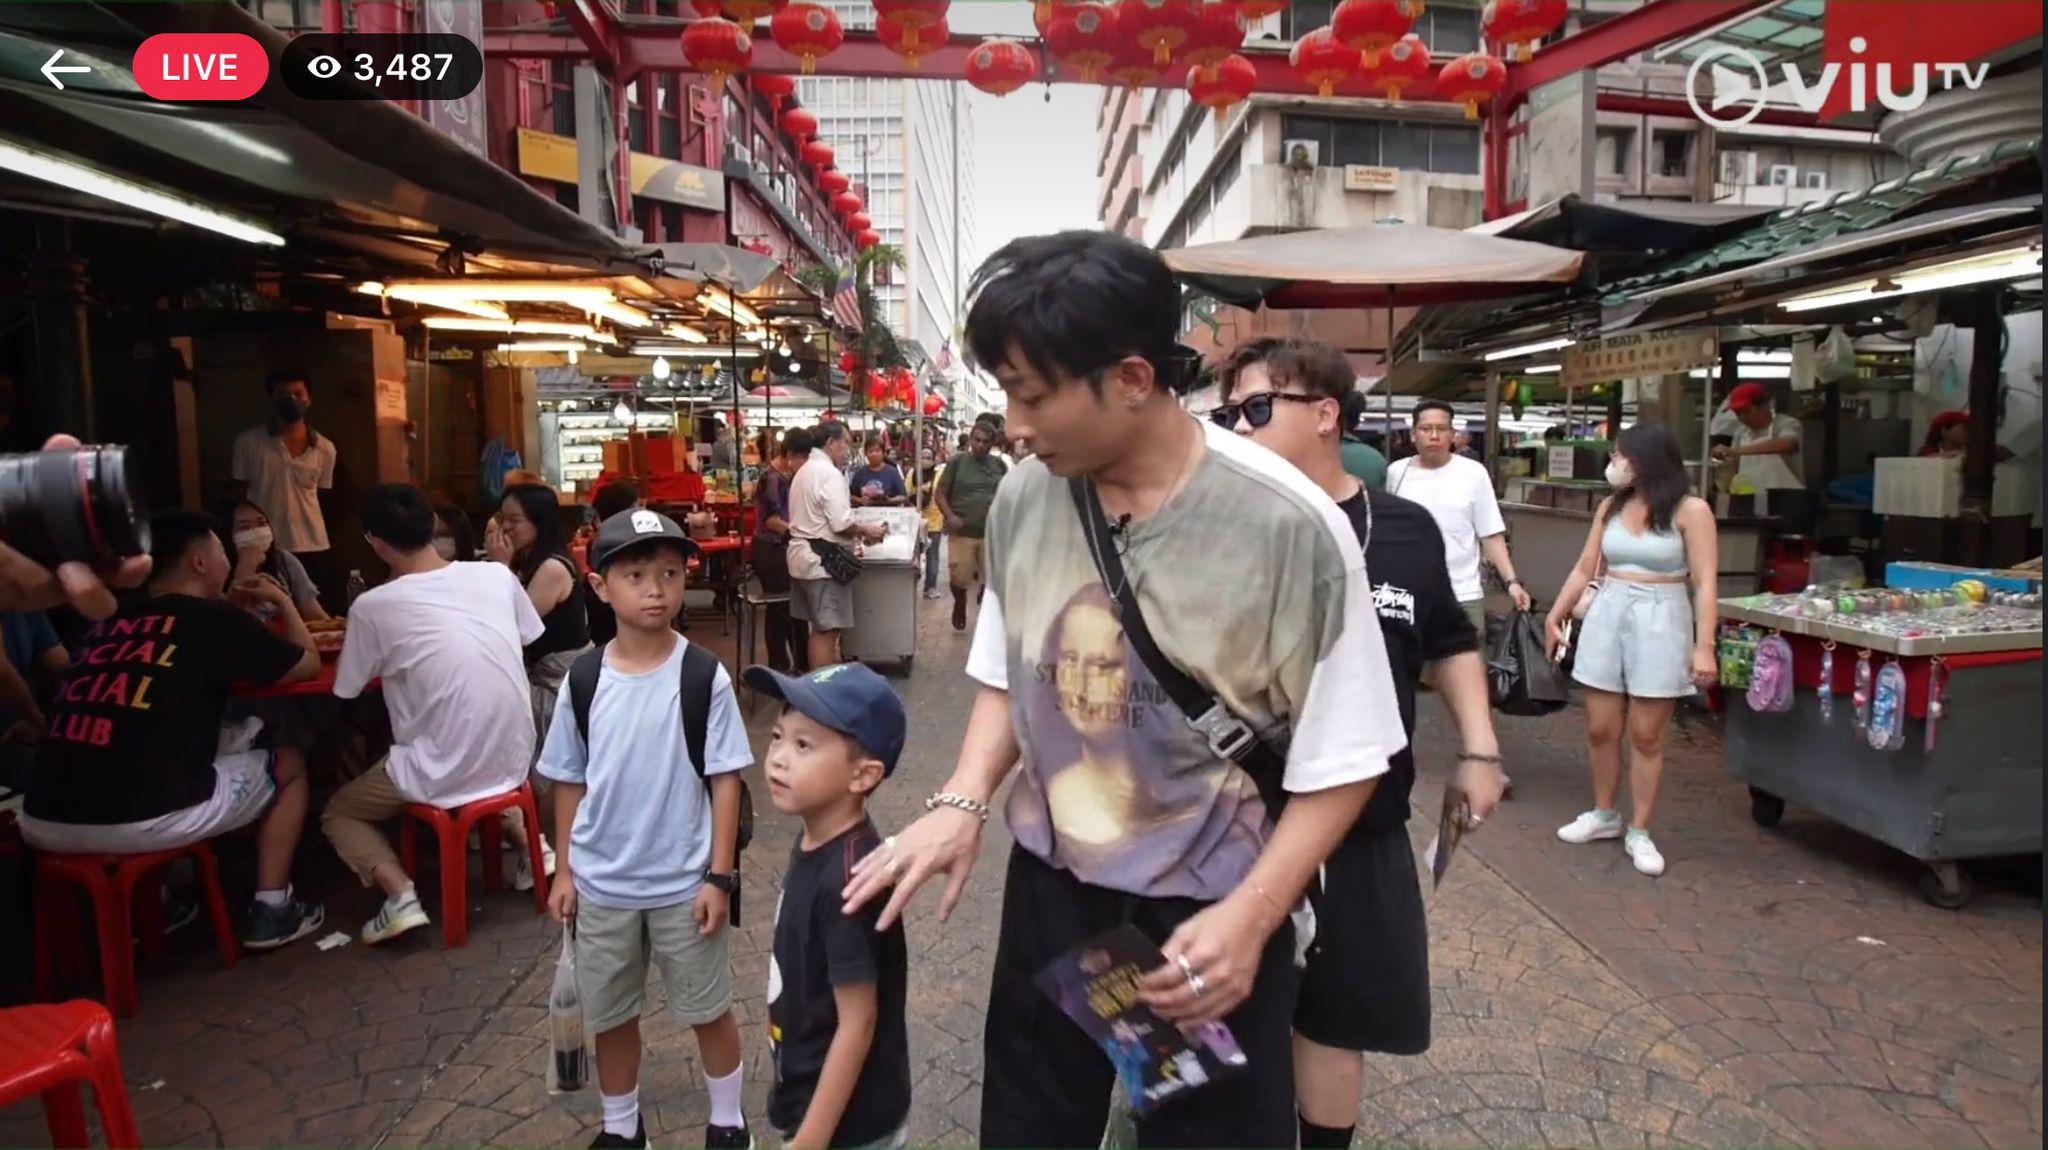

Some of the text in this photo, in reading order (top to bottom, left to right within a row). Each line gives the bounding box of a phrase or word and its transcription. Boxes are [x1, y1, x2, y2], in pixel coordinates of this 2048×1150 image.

[1582, 339, 1601, 354] AIR
[1607, 334, 1642, 349] MATA
[85, 615, 176, 637] ANTI
[49, 714, 113, 746] LUB
